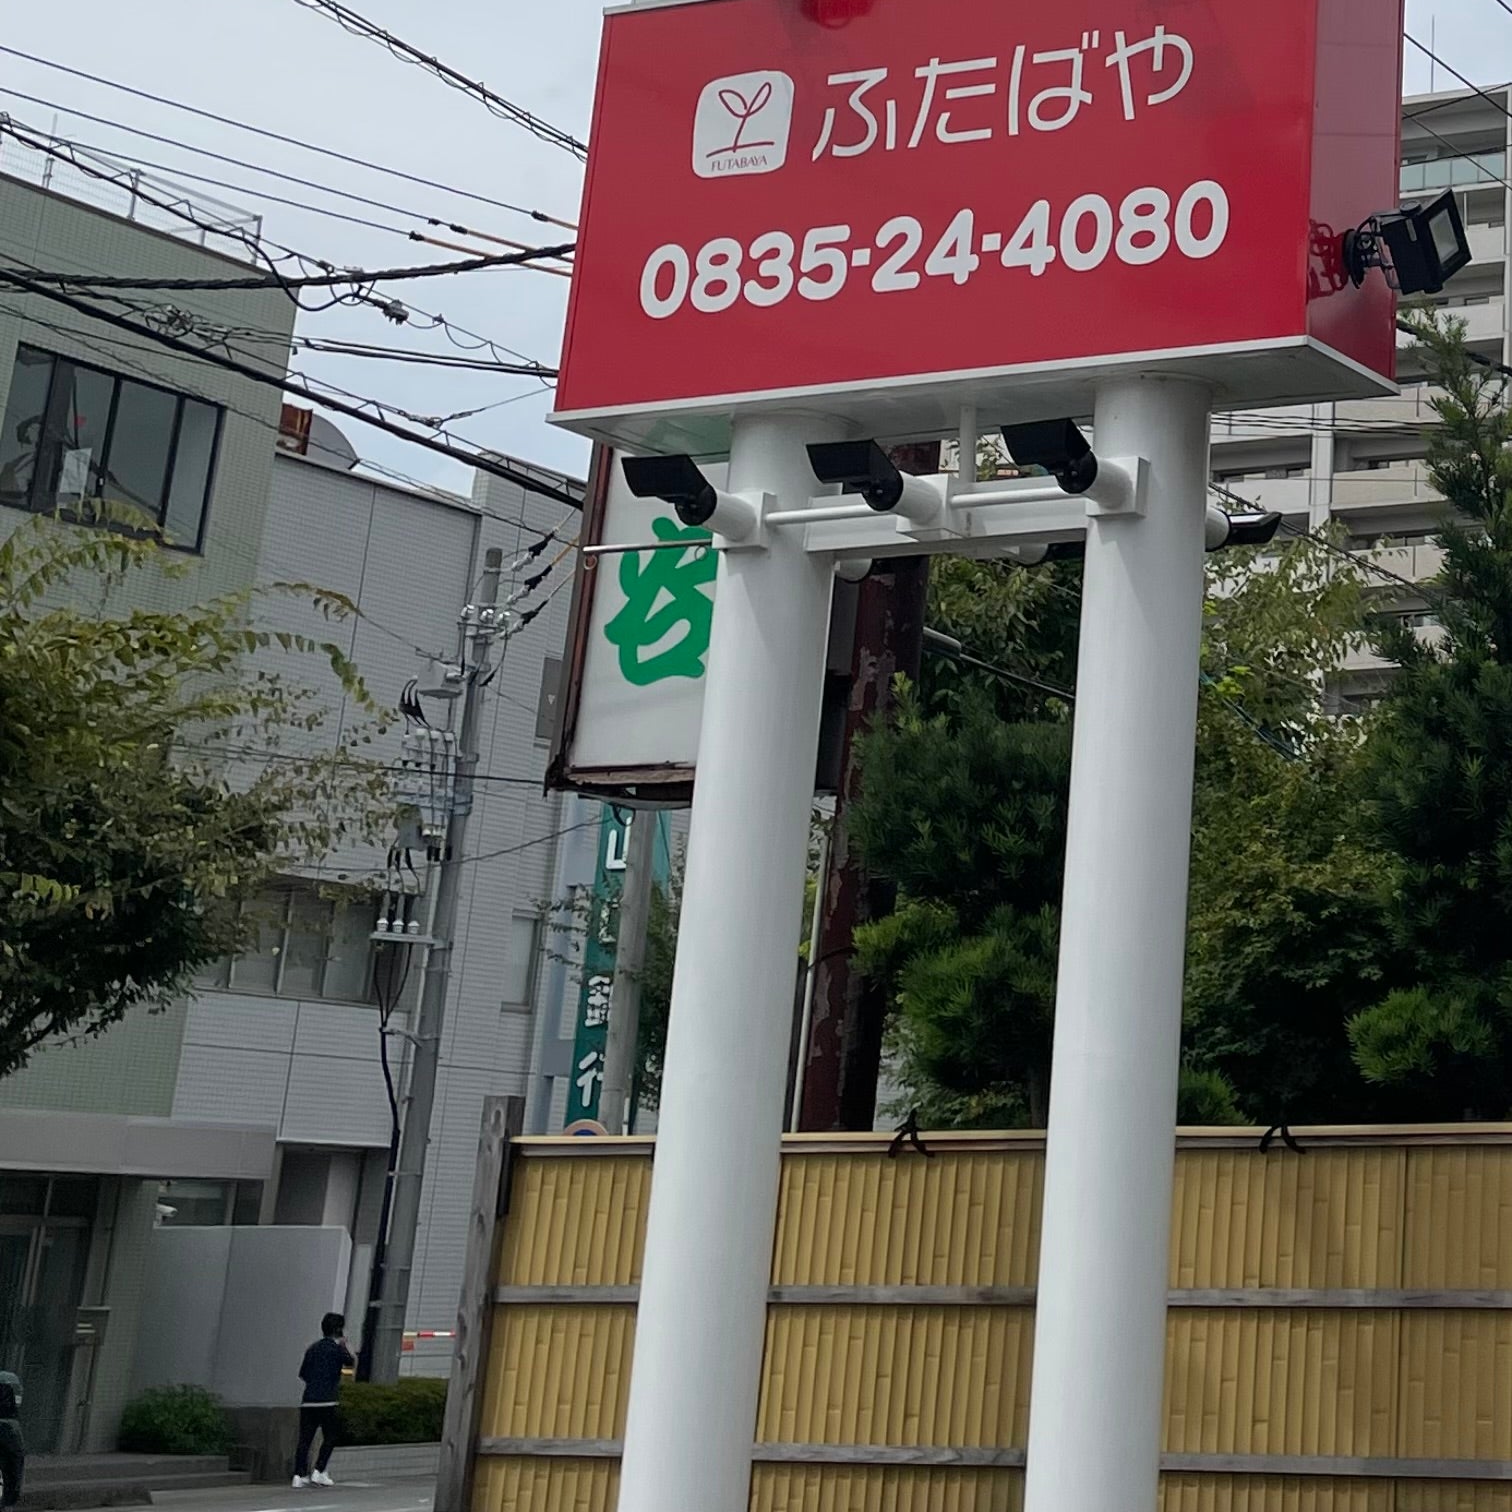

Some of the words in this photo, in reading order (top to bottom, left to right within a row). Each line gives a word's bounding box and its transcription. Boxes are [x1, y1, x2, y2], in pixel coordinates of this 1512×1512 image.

[811, 24, 1195, 162] ふたばや
[710, 154, 768, 172] FUTABAYA
[639, 178, 1230, 320] 0835-24-4080
